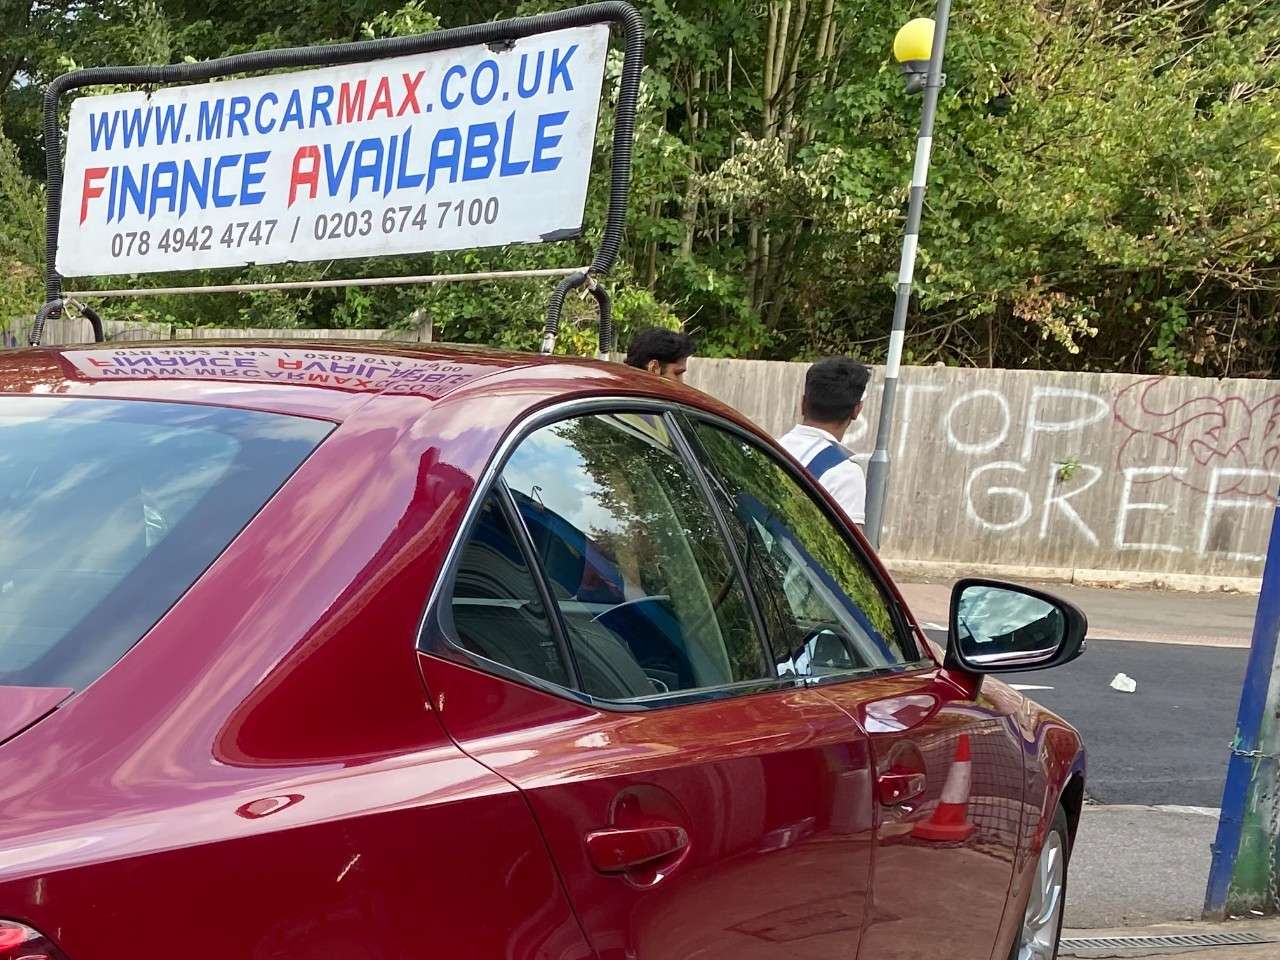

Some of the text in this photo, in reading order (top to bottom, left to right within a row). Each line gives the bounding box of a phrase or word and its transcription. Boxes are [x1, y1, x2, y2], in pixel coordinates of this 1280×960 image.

[89, 44, 580, 152] WWW.MRCARMAX.CO.UK
[80, 110, 570, 226] FINANCE AVAILABLE
[111, 196, 499, 258] 078 4942 4747 / 0203 674 7100
[841, 384, 1110, 460] TOP
